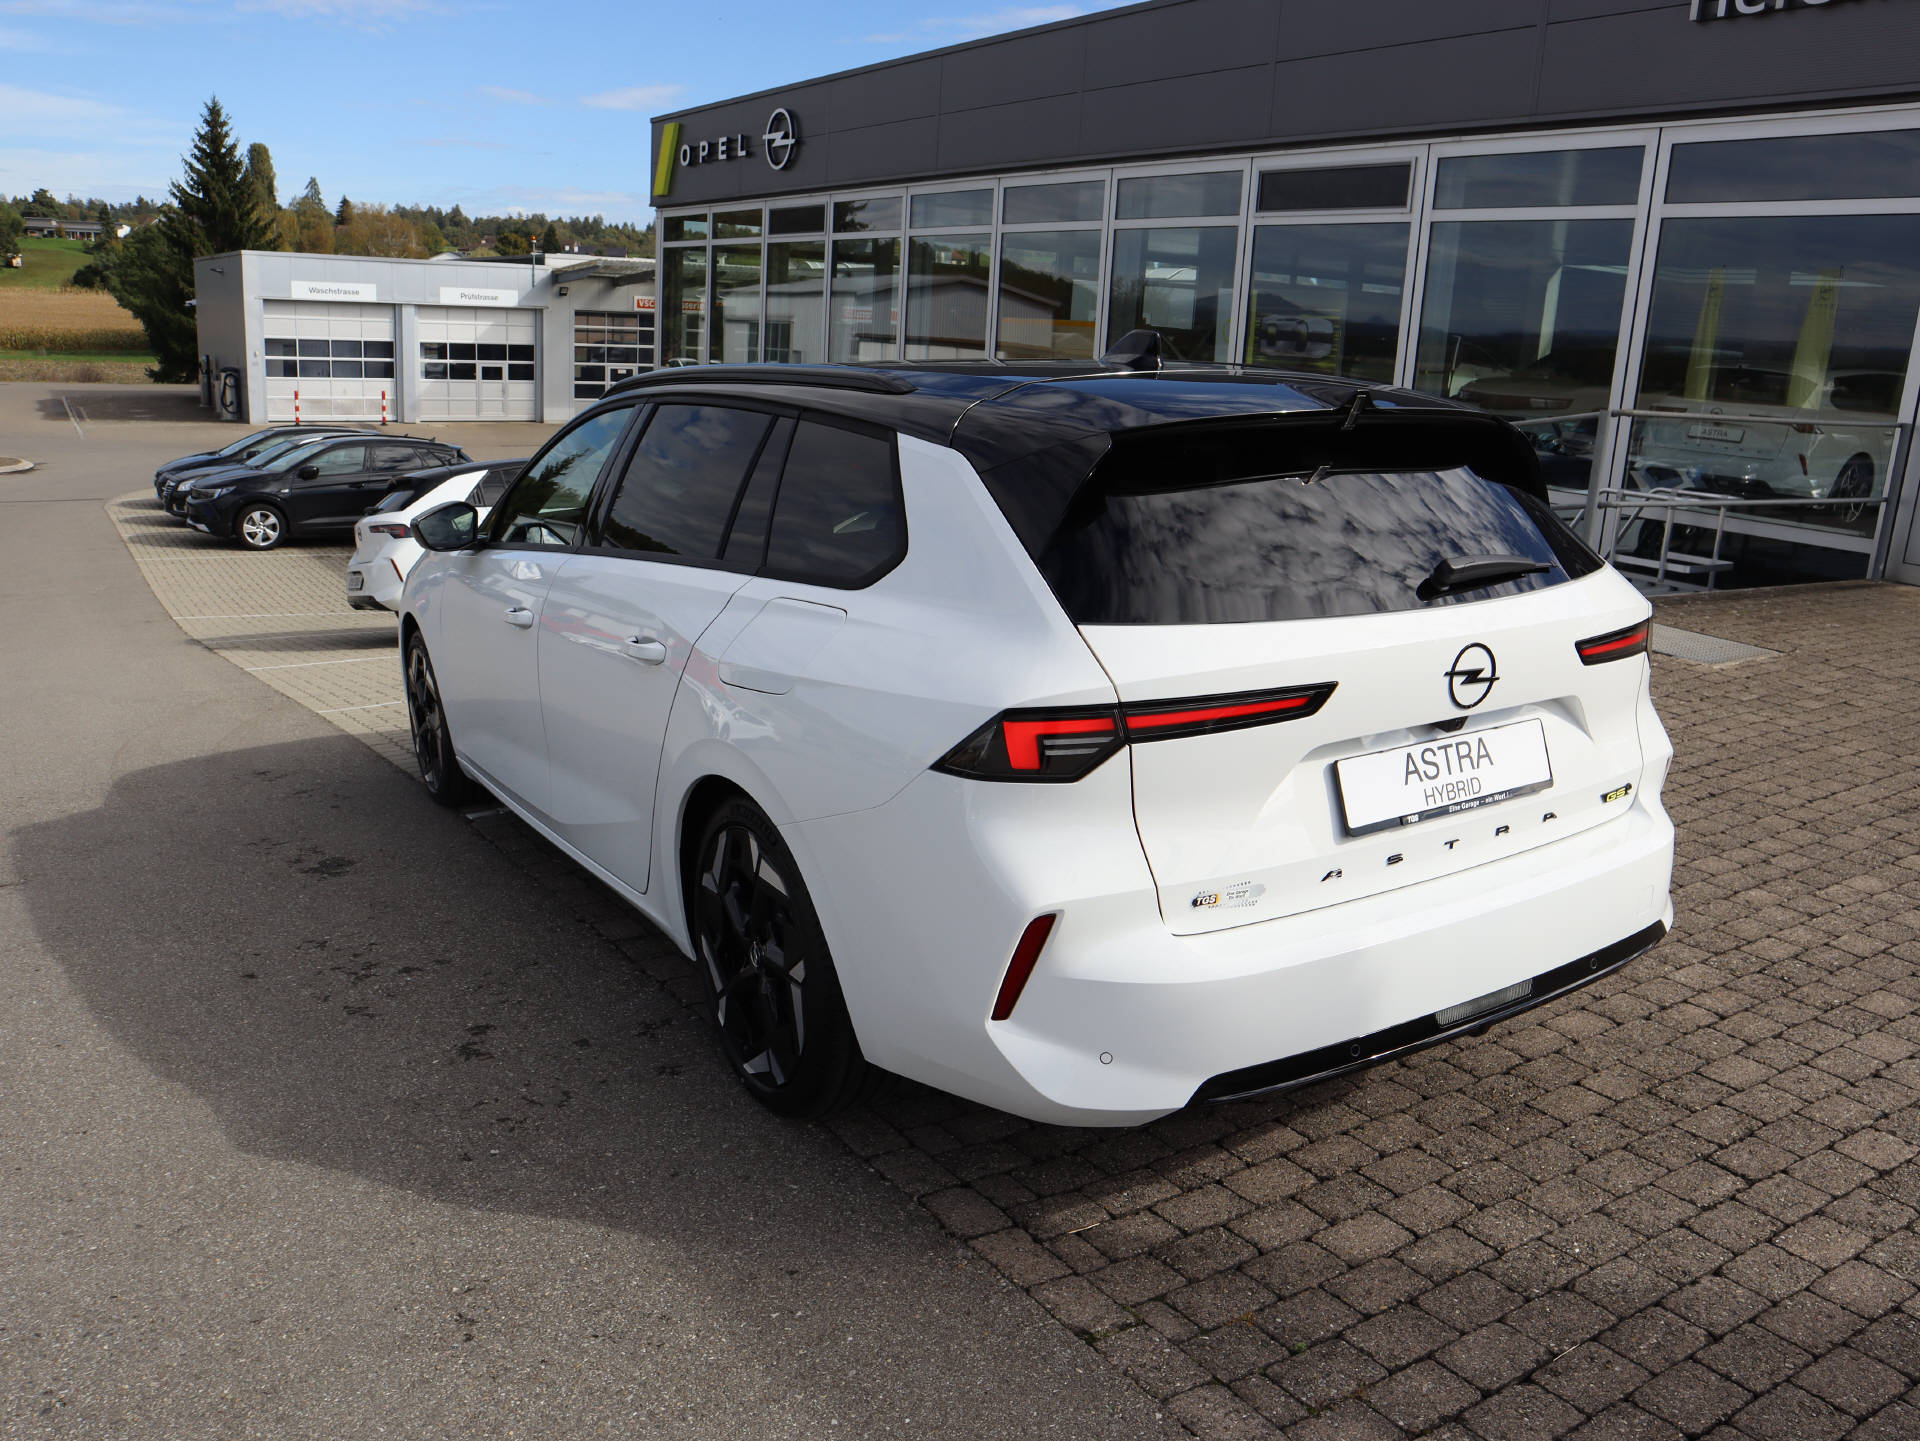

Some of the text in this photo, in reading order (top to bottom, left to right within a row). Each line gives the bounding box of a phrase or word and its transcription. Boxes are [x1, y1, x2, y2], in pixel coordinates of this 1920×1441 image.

[680, 134, 747, 167] OPEL
[308, 286, 360, 296] Waschstrasse
[460, 291, 499, 301] Prüfstrasse
[1404, 736, 1494, 786] ASTRA
[1423, 777, 1482, 807] HYBRID
[1449, 804, 1460, 813] Eine
[1461, 799, 1480, 810] Garage
[1196, 894, 1217, 906] TGS
